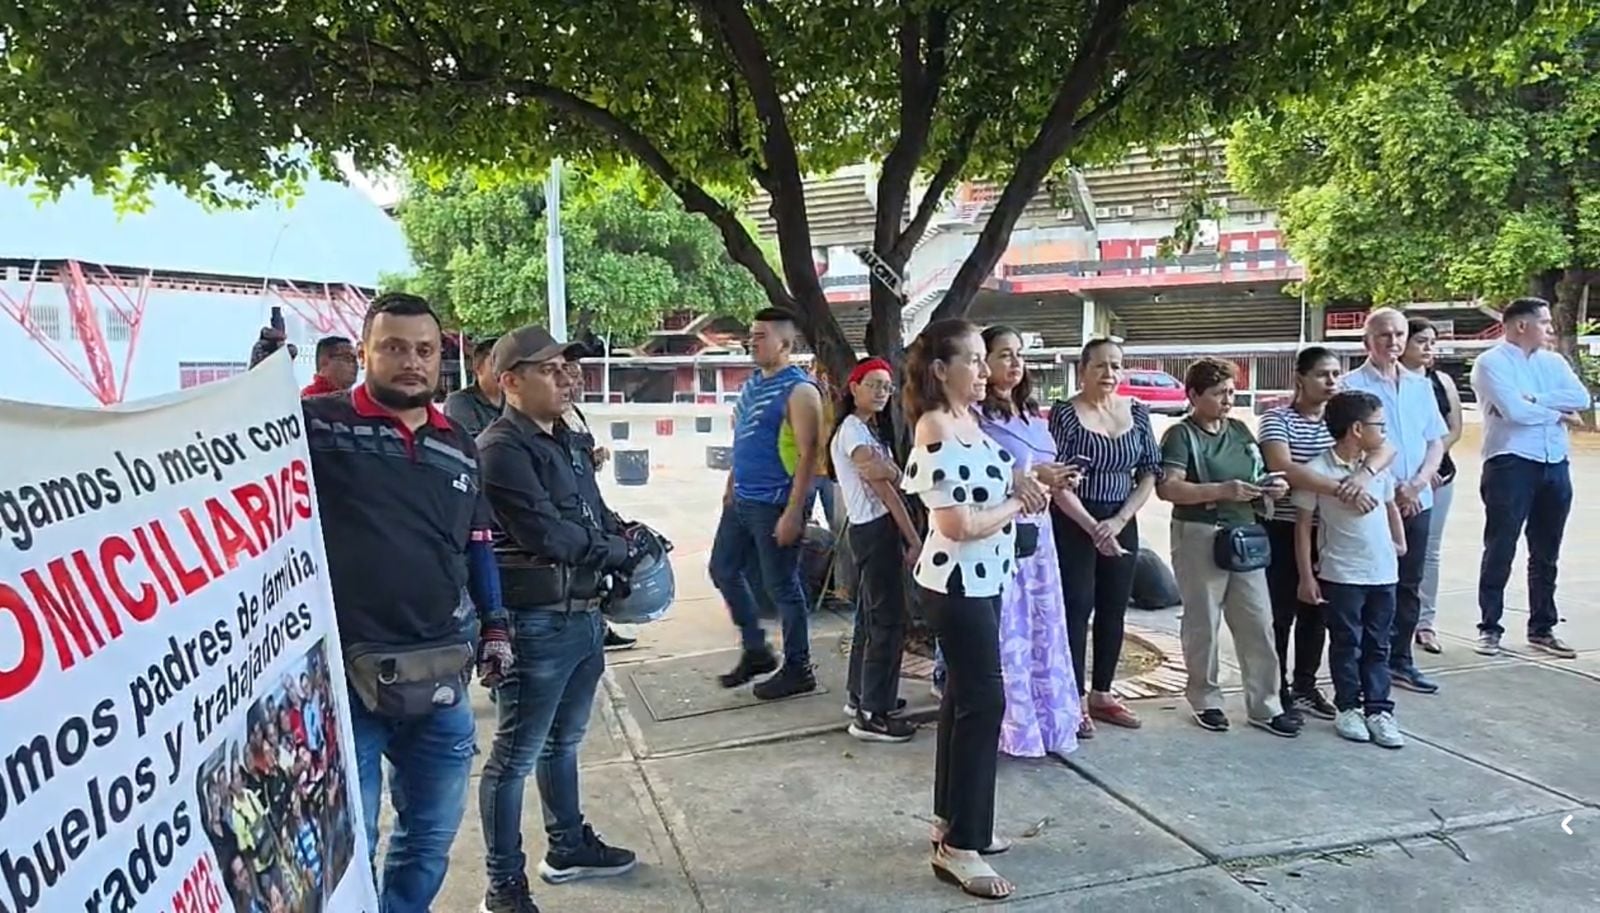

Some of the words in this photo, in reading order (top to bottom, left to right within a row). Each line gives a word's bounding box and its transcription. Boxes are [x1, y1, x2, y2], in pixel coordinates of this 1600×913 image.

[0, 467, 122, 551] gamos
[115, 450, 156, 497] lo
[157, 431, 246, 482] mejor
[0, 698, 119, 822] mos
[129, 618, 233, 738] padres
[237, 590, 259, 639] de
[0, 756, 156, 913] buelos
[164, 721, 184, 784] y
[193, 602, 312, 744] trabajadores
